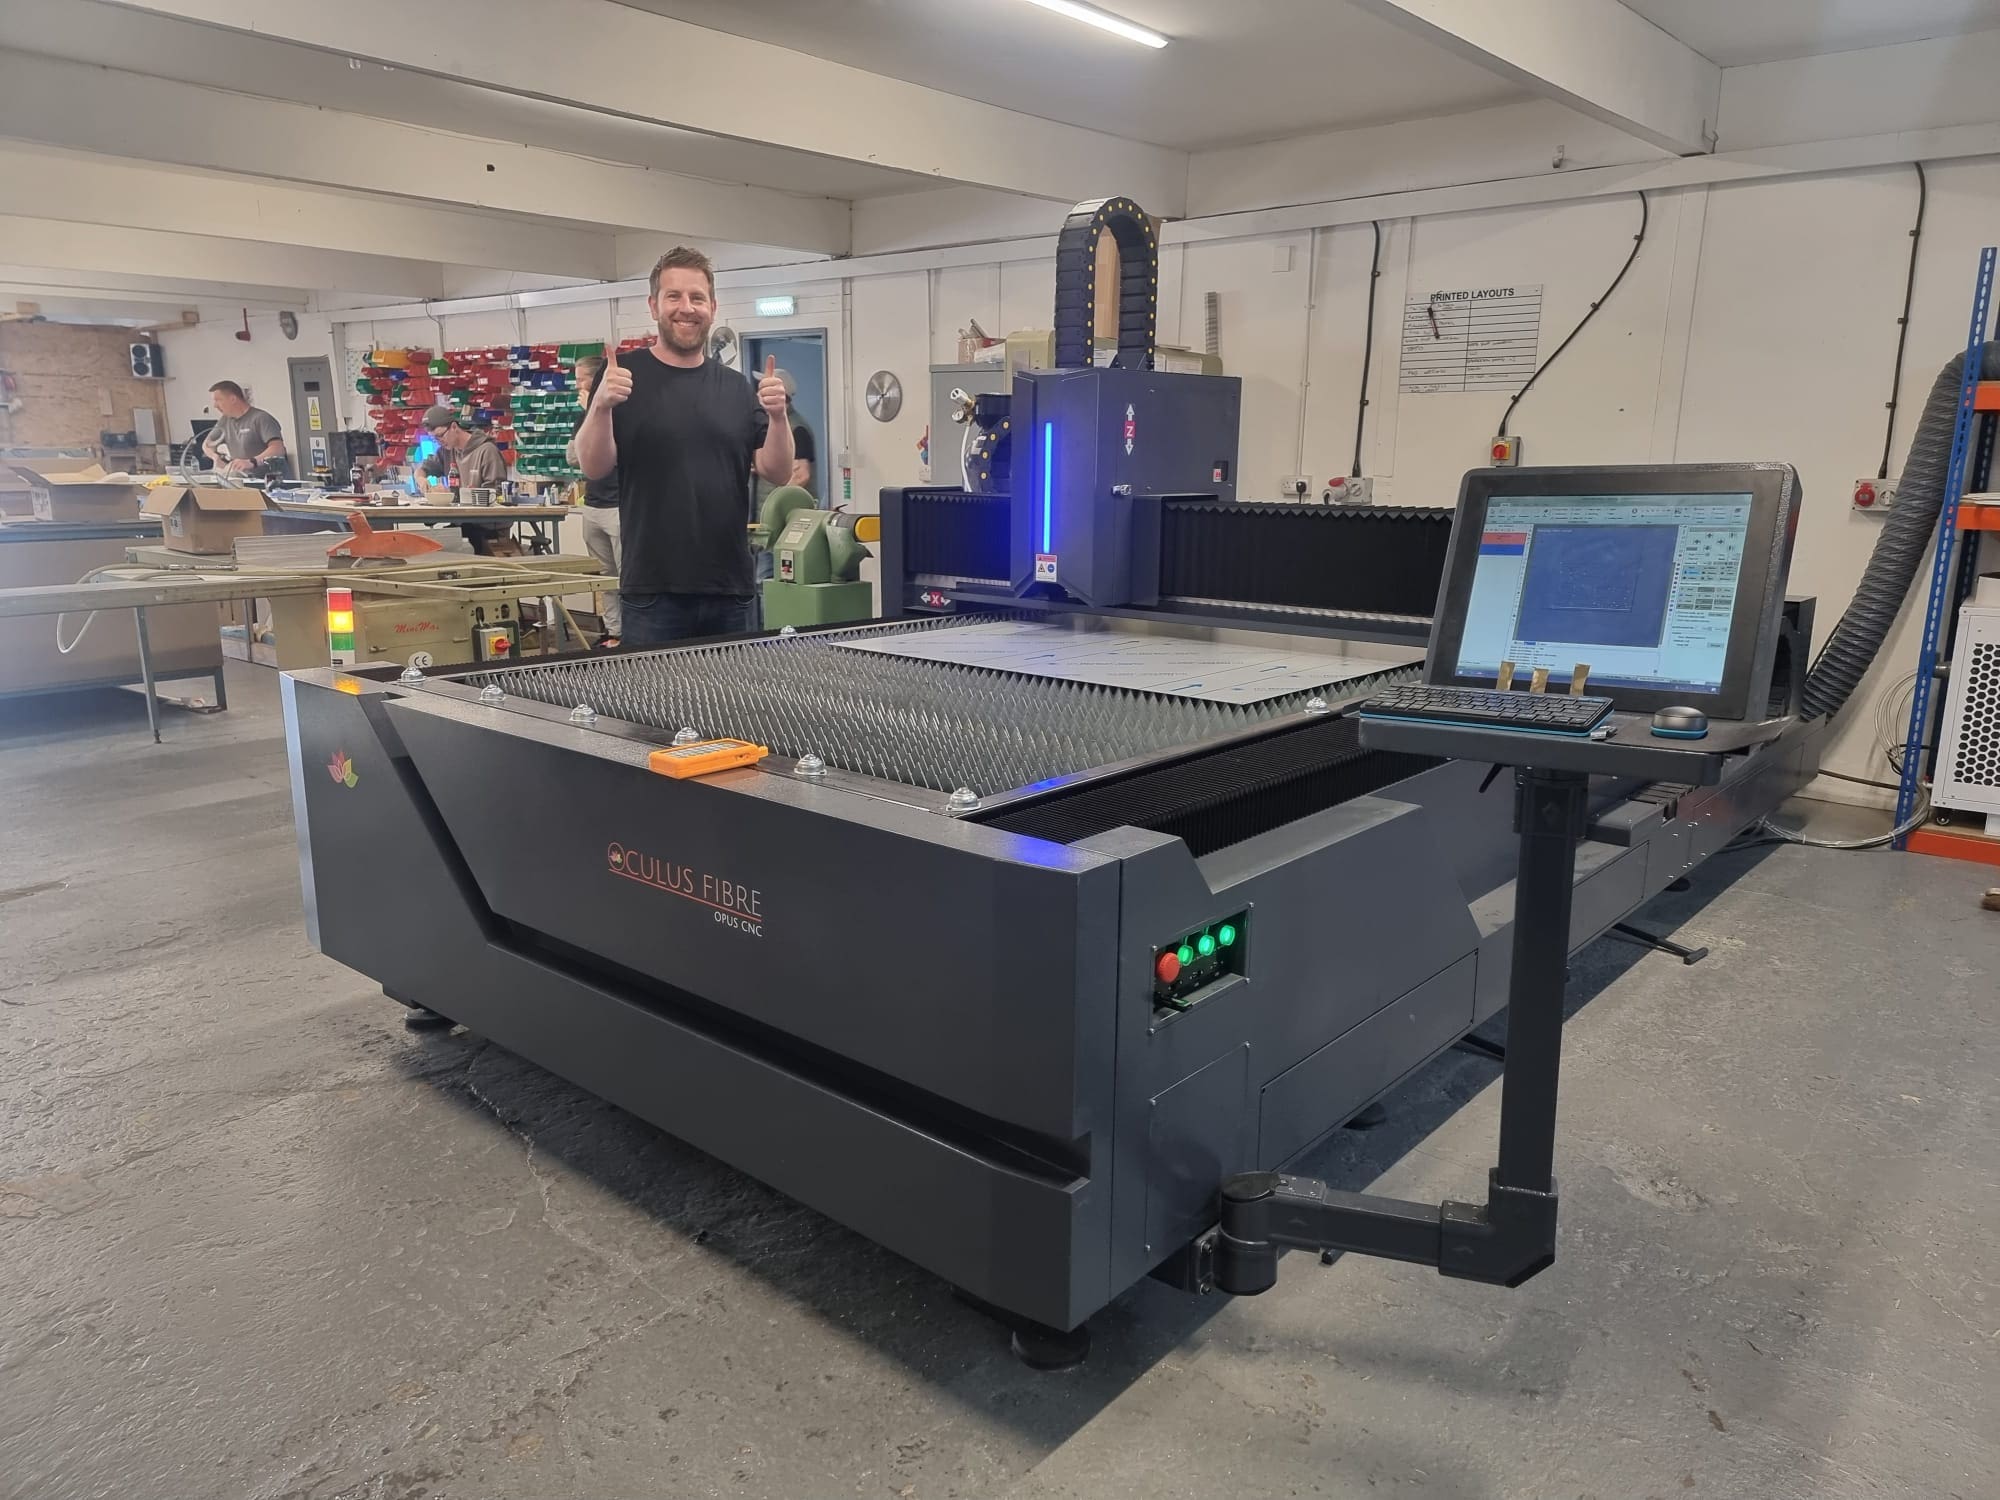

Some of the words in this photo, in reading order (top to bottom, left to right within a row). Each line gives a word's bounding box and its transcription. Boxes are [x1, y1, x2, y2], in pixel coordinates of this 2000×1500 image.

[1430, 292, 1469, 302] PRINTED
[1471, 288, 1515, 299] LAYOUTS
[1126, 425, 1134, 437] Z
[932, 594, 940, 604] X
[414, 655, 428, 667] CE
[607, 842, 695, 894] OCULUS
[703, 873, 762, 918] FIBRE
[713, 911, 739, 929] OPUS
[740, 920, 763, 937] CNC
